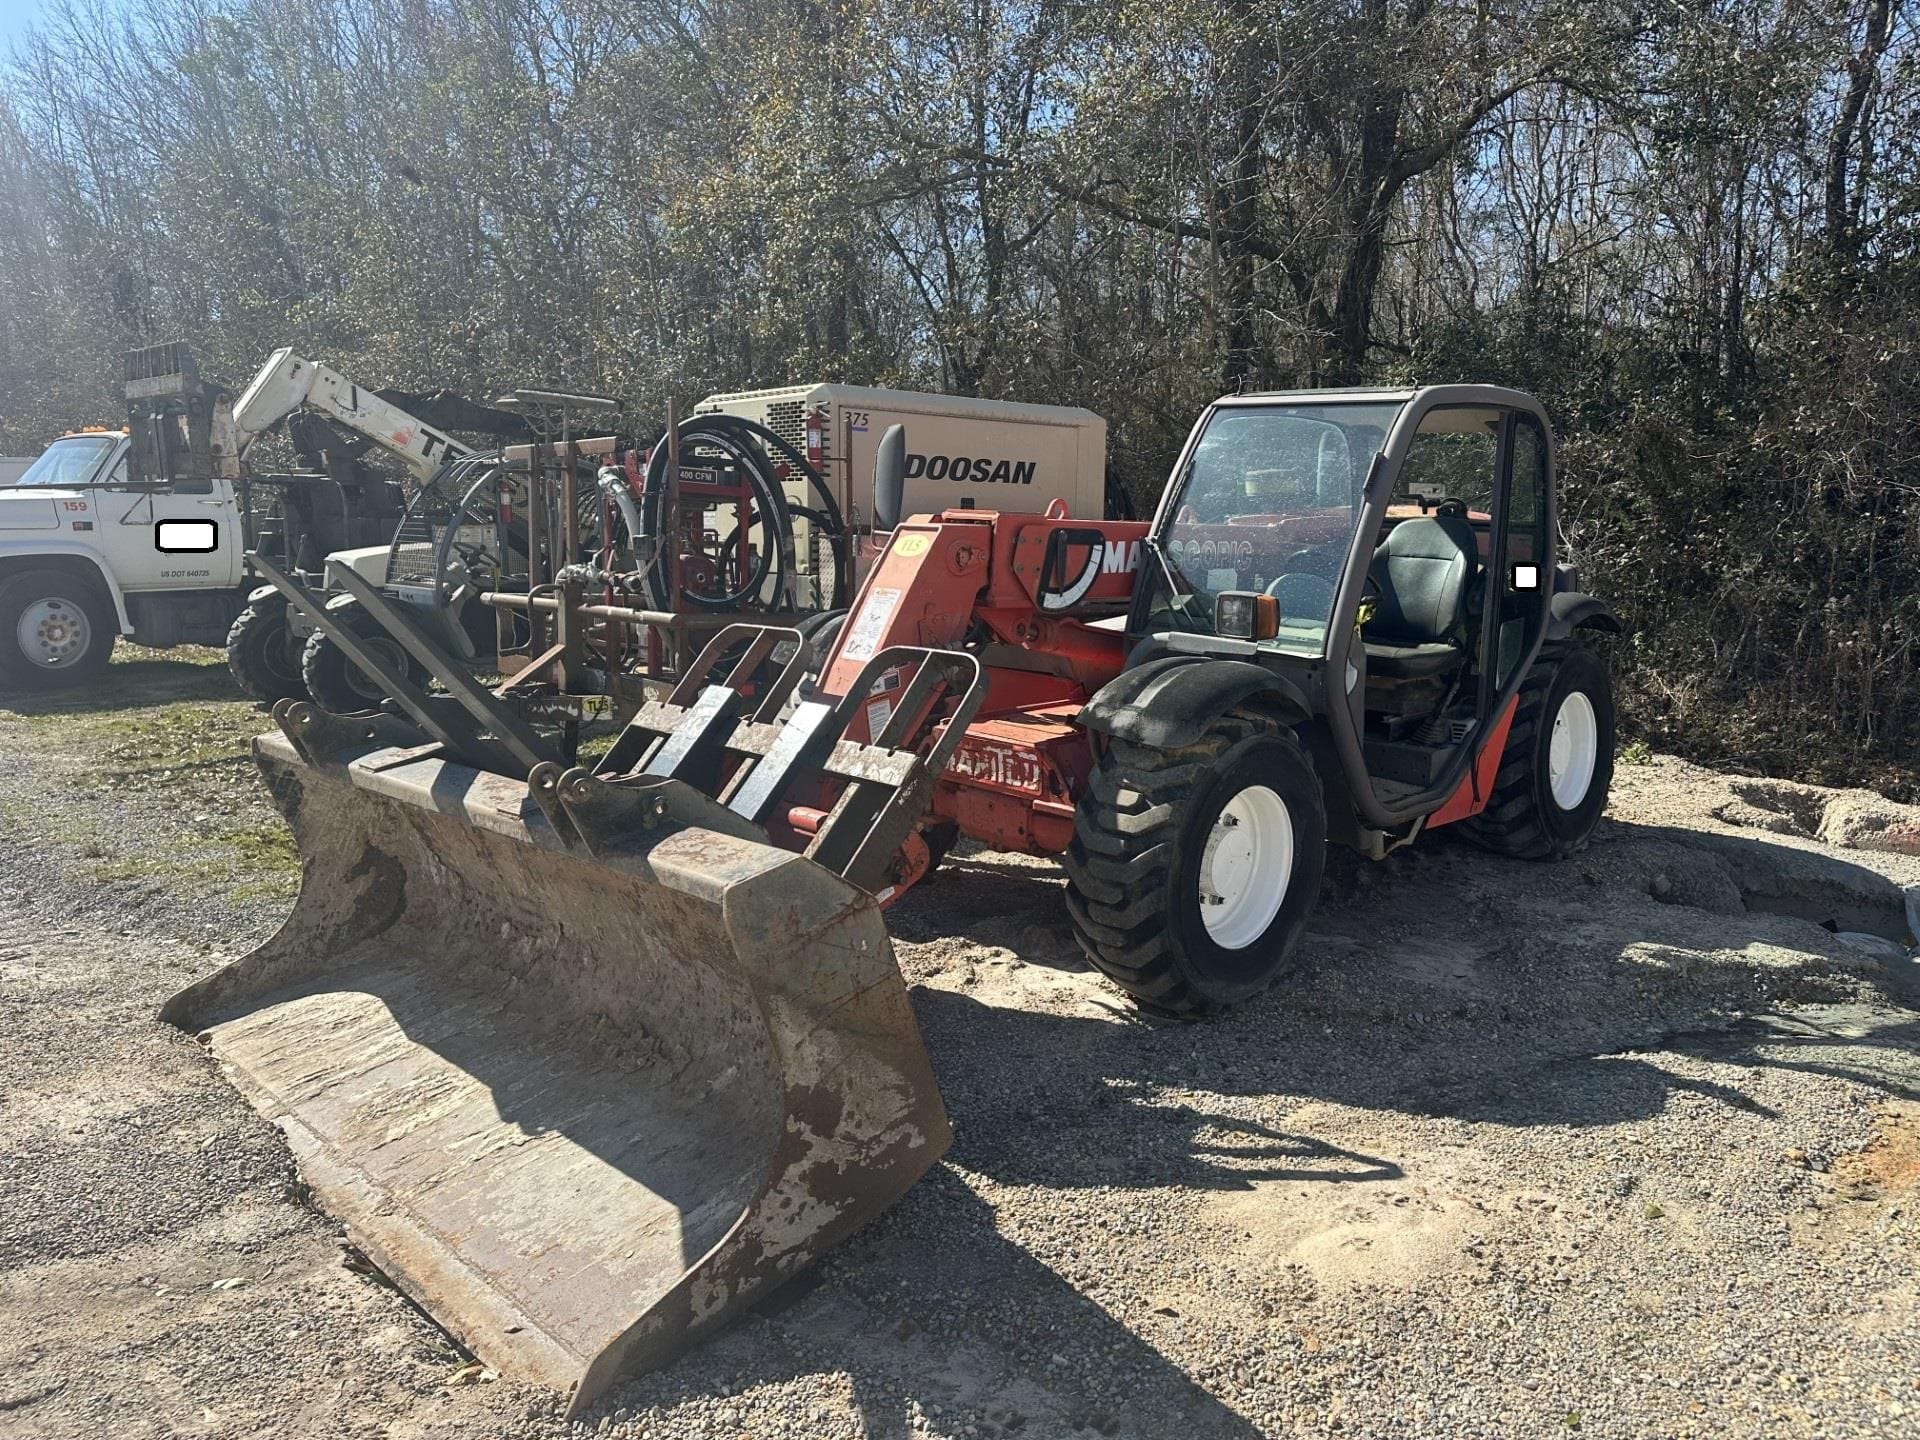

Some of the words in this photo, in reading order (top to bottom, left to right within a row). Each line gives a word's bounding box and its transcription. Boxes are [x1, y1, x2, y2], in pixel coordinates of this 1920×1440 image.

[905, 453, 1037, 485] DOOSAN
[680, 470, 693, 480] 400
[695, 472, 712, 481] CFM
[63, 501, 87, 512] 159
